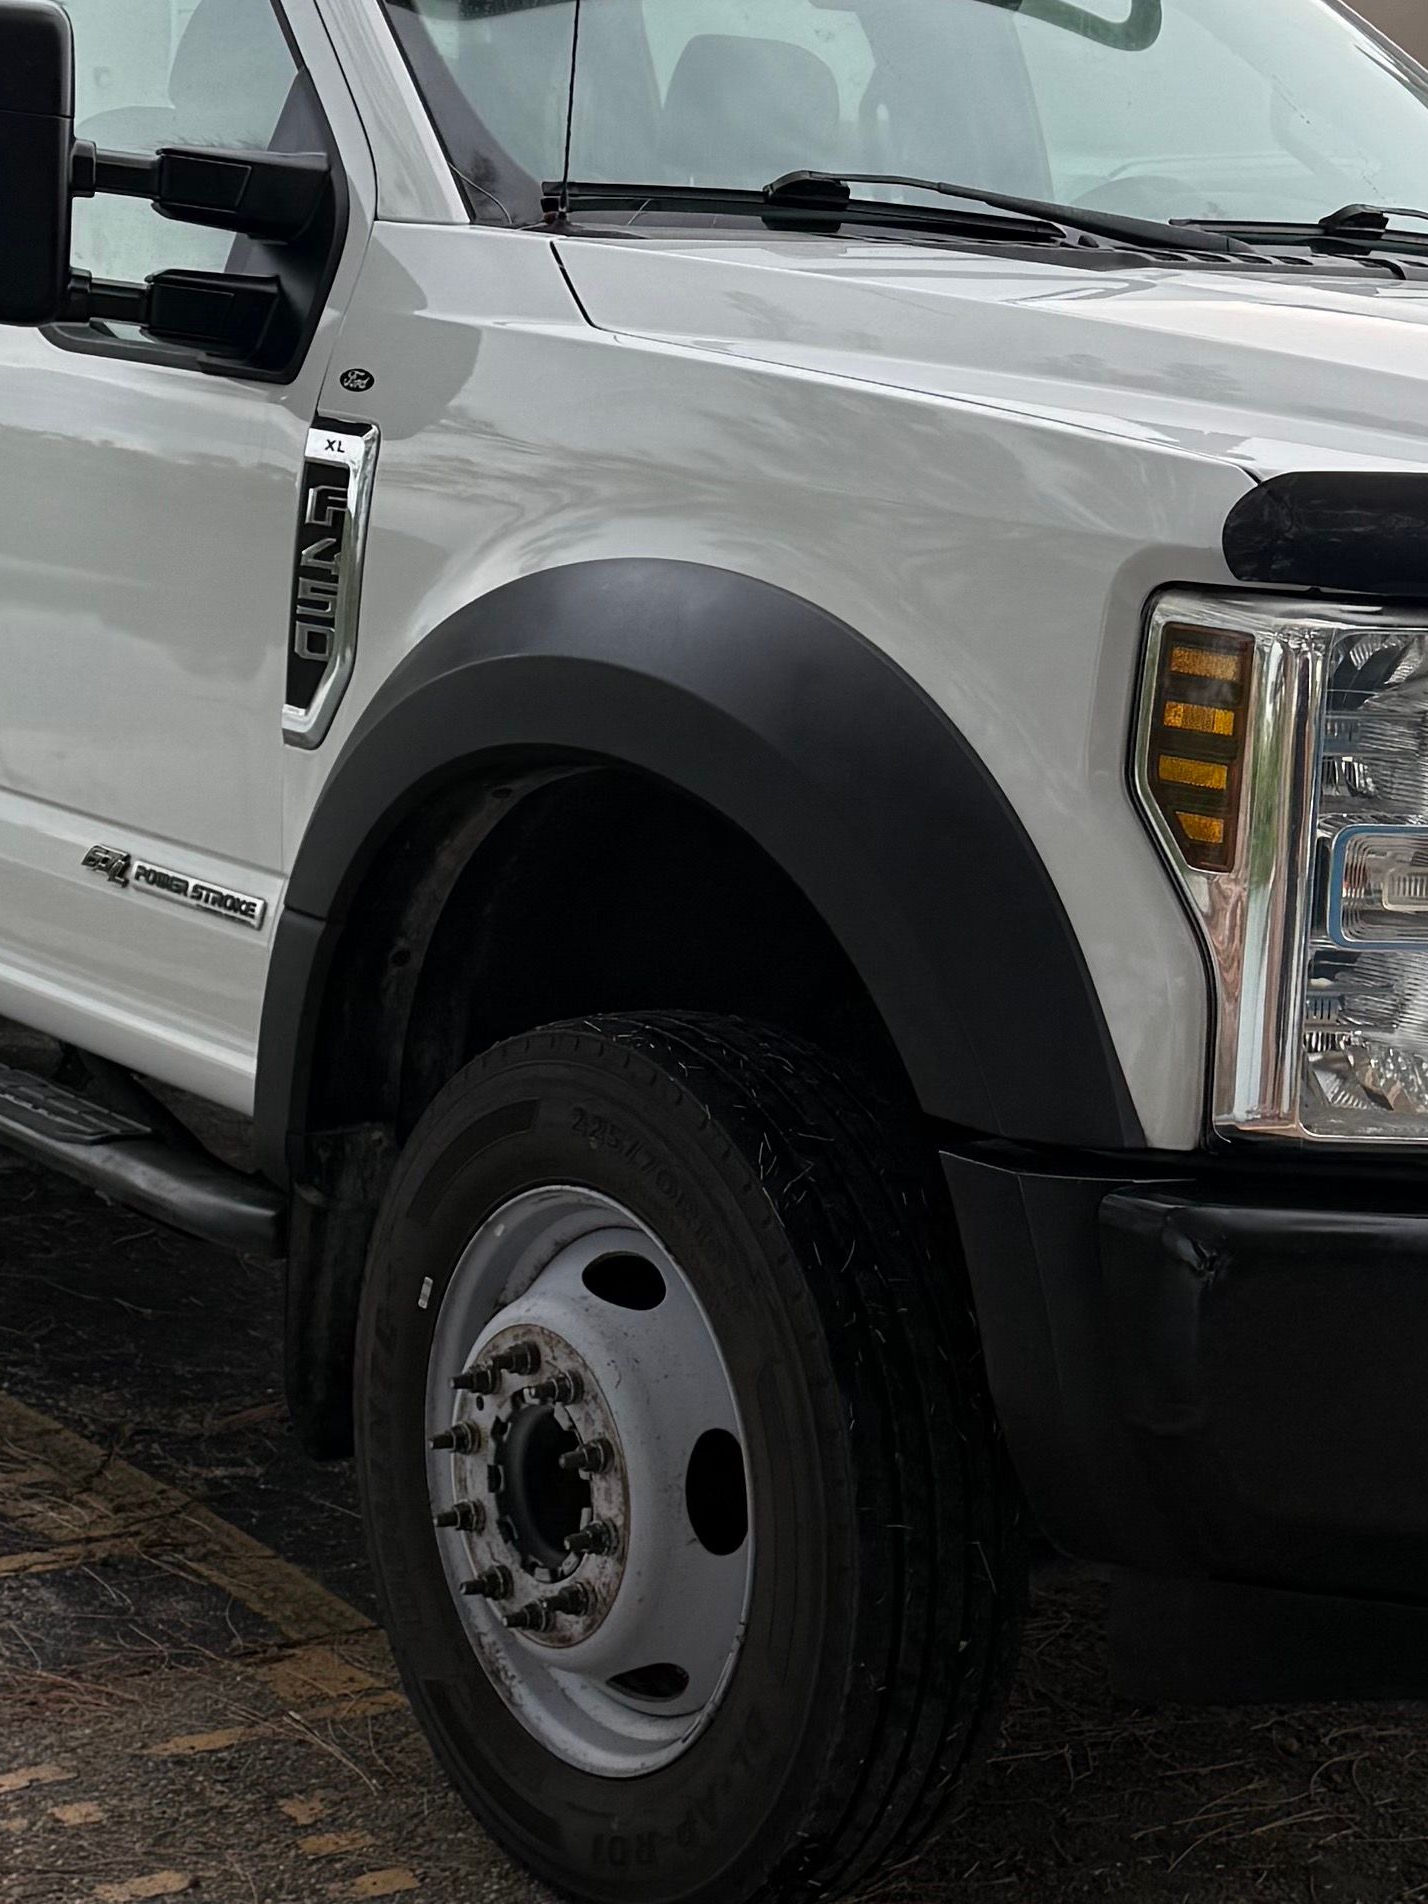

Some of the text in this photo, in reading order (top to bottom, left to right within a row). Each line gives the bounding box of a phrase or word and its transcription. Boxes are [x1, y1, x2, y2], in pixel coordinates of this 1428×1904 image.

[324, 438, 346, 454] XL
[134, 864, 190, 897] POWER
[190, 883, 258, 919] STROKE
